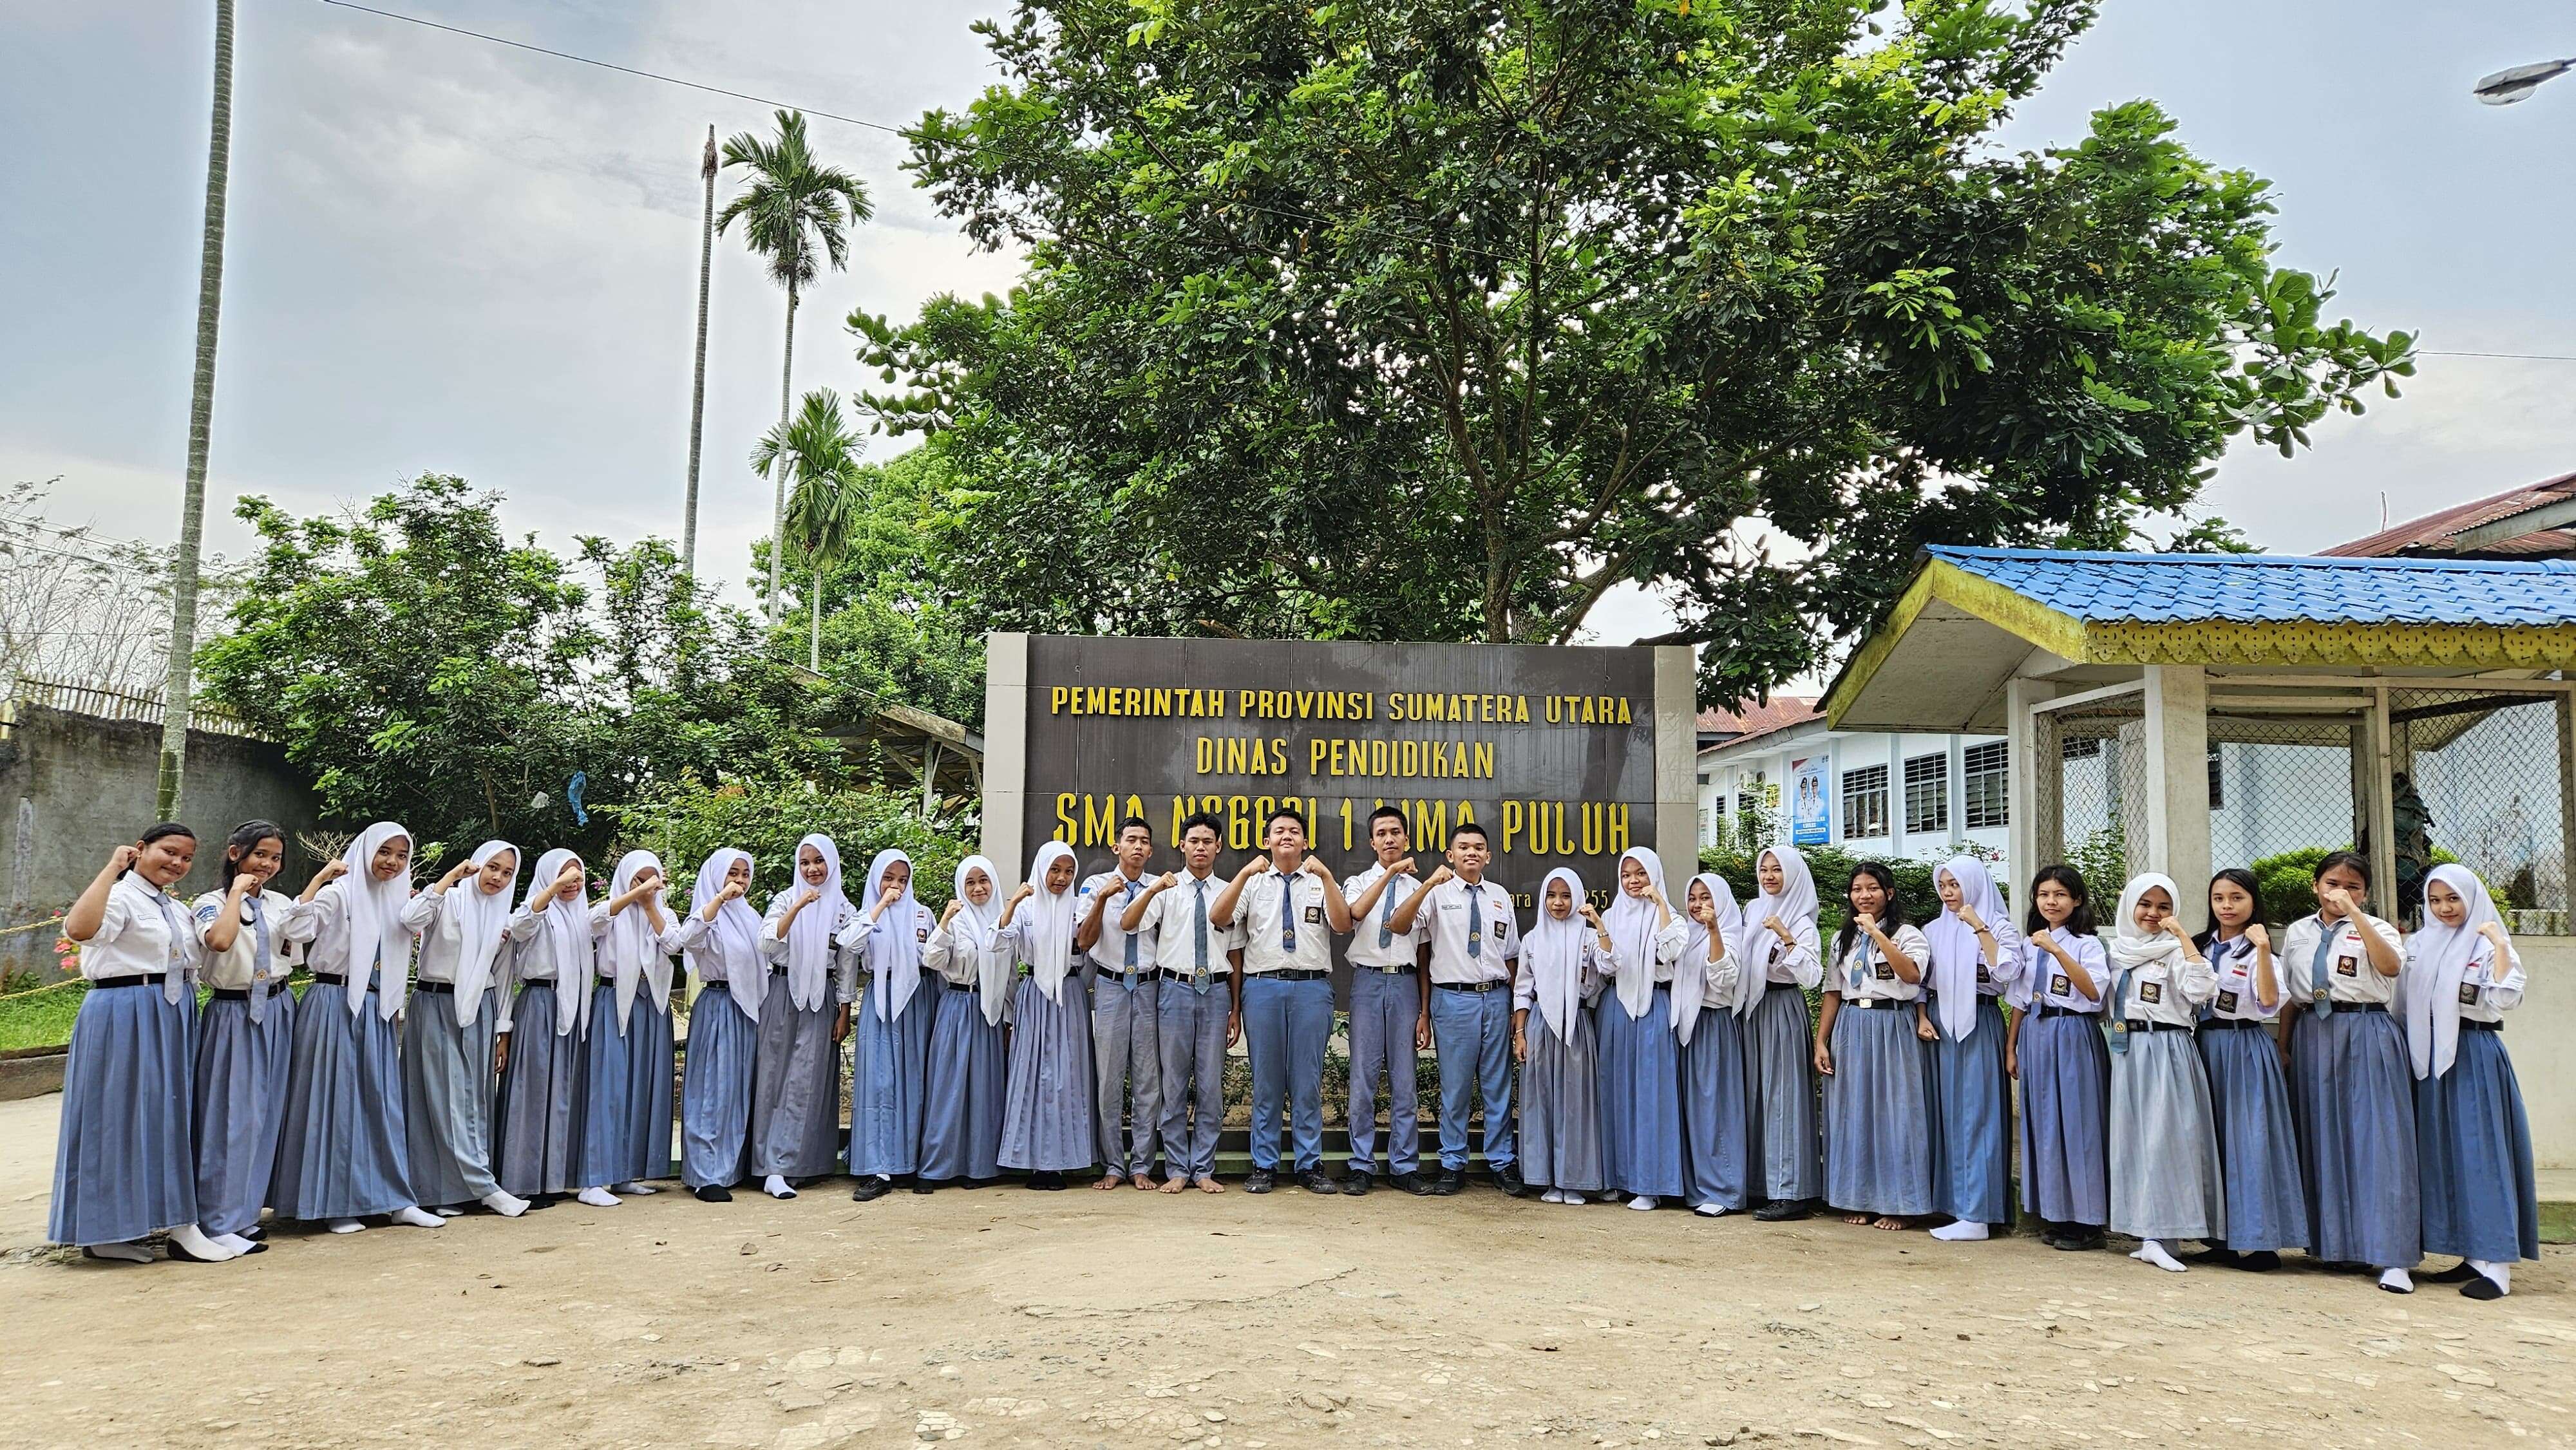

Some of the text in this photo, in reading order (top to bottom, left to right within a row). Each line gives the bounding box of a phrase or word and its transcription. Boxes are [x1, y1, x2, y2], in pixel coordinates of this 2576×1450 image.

[1051, 686, 1633, 724] PEMERINTAH PROVINSI SUMATERA UTARA
[1196, 736, 1493, 778] DINAS PENDIDIKAN
[1339, 798, 1353, 851] 1
[1374, 798, 1475, 853] IM
[1502, 800, 1629, 855] PULUH
